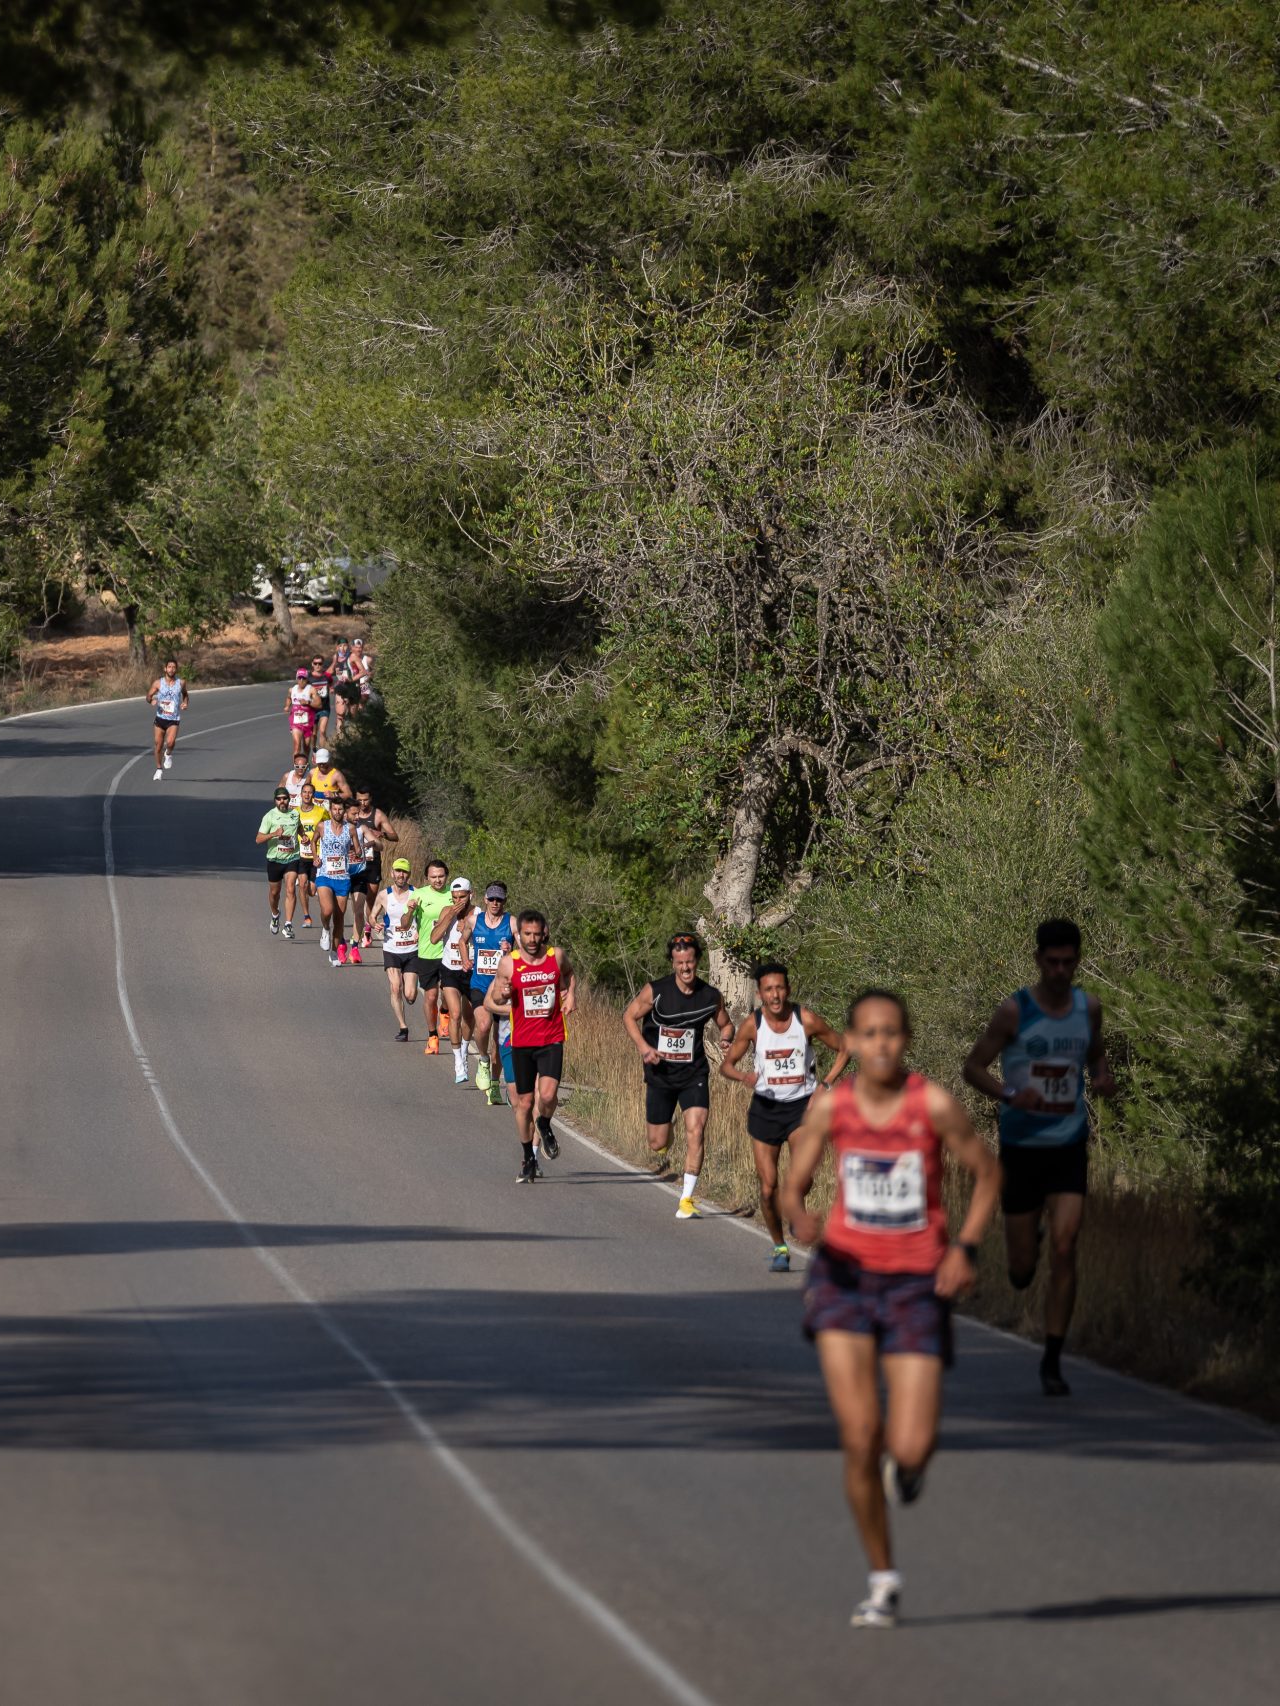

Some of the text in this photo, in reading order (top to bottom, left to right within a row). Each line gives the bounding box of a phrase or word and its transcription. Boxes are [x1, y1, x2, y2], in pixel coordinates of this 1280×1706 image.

[400, 930, 413, 939] 236
[483, 957, 497, 966] 812
[520, 973, 548, 983] OZONO
[532, 994, 549, 1006] 543
[666, 1037, 686, 1049] 849
[774, 1058, 796, 1071] 945
